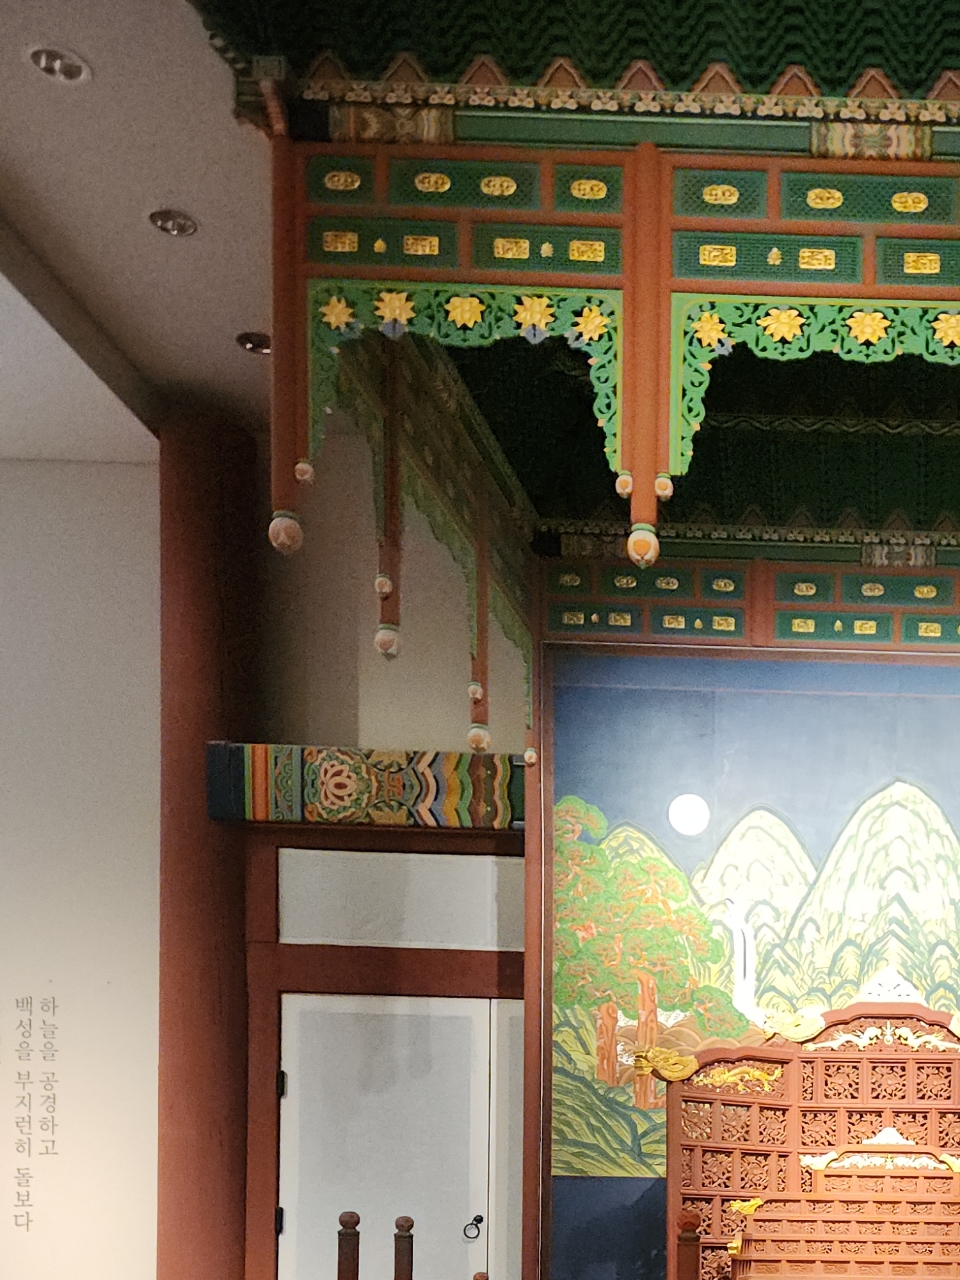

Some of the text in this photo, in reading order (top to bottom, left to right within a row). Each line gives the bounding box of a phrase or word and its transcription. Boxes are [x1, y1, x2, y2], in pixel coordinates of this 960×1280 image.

[13, 996, 35, 1233] 백성을 부지런히 돌보다
[38, 996, 60, 1156] 하늘을 공경하고
